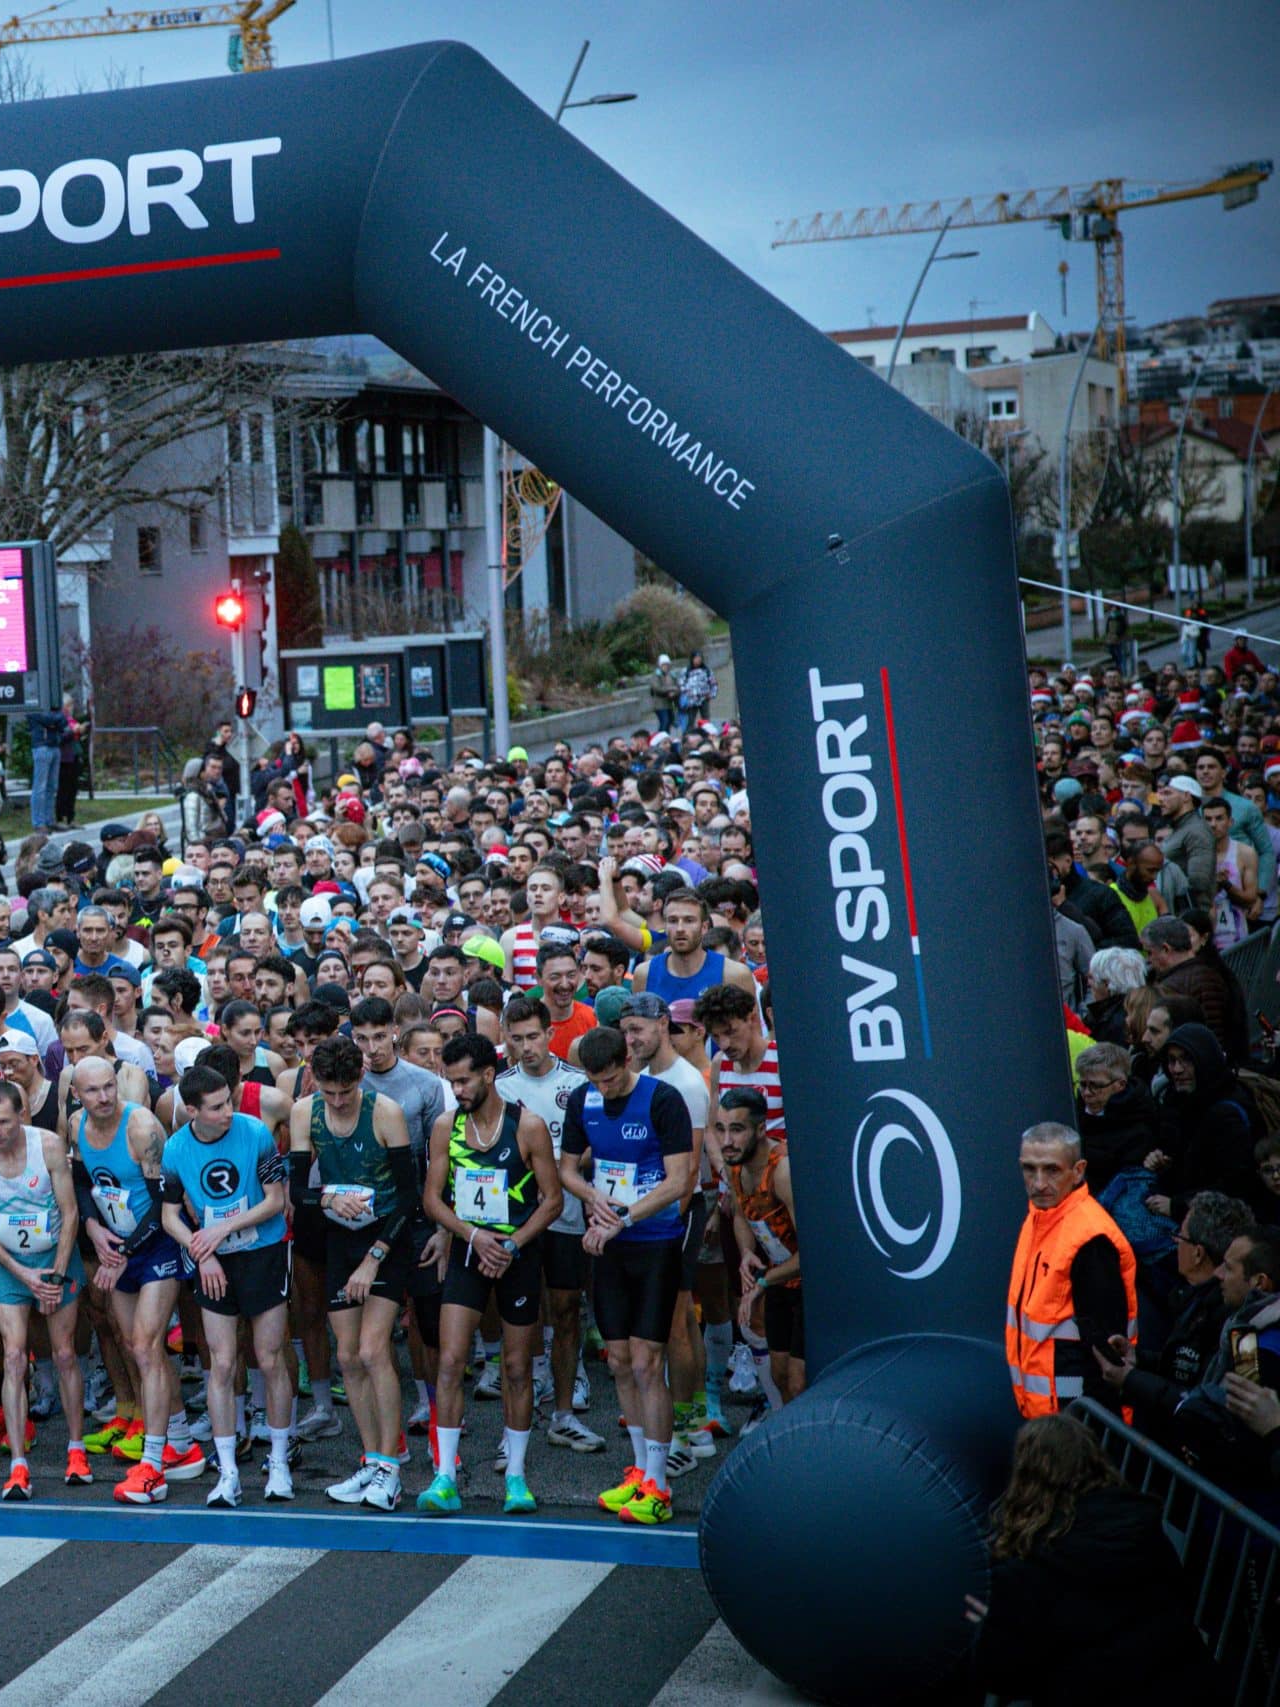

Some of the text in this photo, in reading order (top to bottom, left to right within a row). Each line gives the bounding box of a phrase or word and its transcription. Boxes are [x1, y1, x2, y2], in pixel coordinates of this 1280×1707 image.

[430, 231, 756, 510] LA FRENCH PERFORMANCE
[808, 667, 906, 1062] BV SPORT
[473, 1186, 487, 1211] 4
[107, 1202, 117, 1225] 1
[17, 1229, 31, 1249] 2
